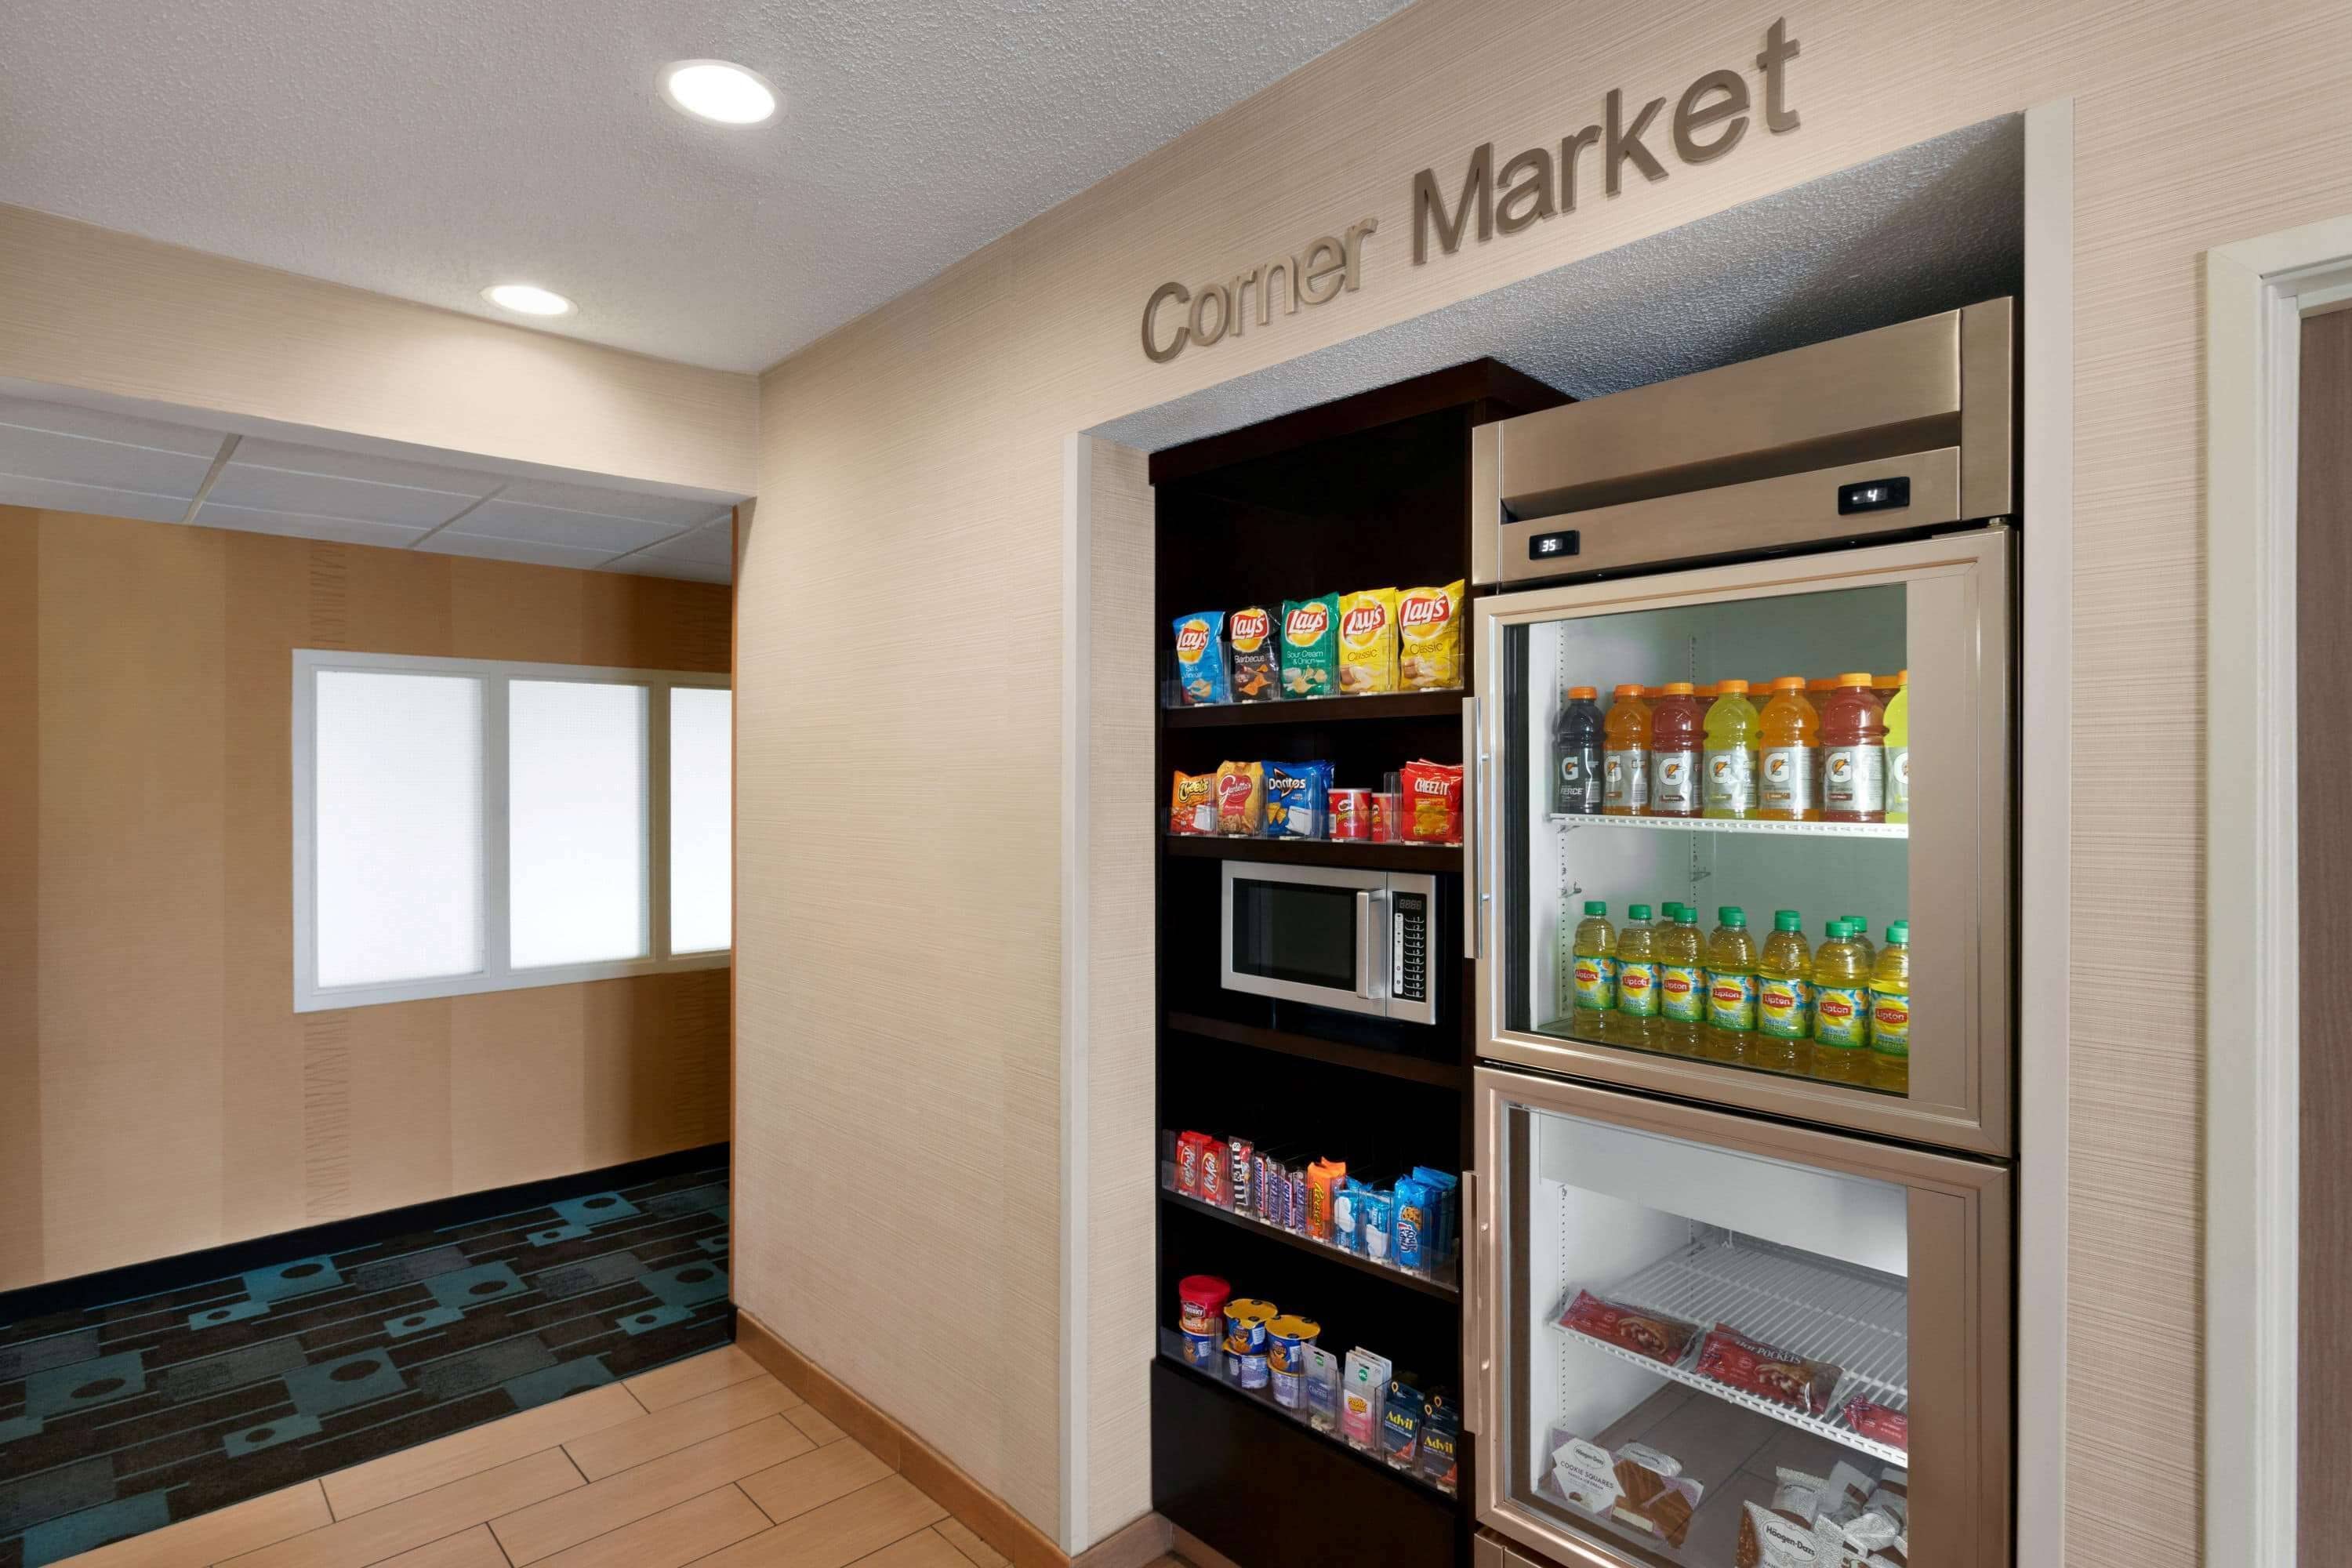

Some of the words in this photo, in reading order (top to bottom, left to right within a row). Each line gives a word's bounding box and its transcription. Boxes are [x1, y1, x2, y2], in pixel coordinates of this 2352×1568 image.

[1141, 216, 1378, 362] Corner
[1413, 16, 1801, 266] Market
[1541, 539, 1556, 552] 35
[1403, 593, 1446, 626] Lay's
[1232, 613, 1265, 640] Lay's
[1288, 611, 1327, 633] Lay's
[1177, 629, 1208, 651] Lay's
[1410, 643, 1443, 655] Classic
[1235, 655, 1265, 663] Barbecue
[1348, 649, 1377, 662] Classic
[1562, 757, 1579, 781] G
[1659, 757, 1686, 786] G
[1765, 752, 1791, 782] G
[1826, 752, 1851, 782] G
[1269, 778, 1306, 790] Doritos
[1337, 811, 1356, 822] Prin
[1576, 971, 1596, 979] Lipton
[1664, 981, 1686, 990] Lipton
[1765, 995, 1790, 1005] Lipton
[1823, 1004, 1849, 1013] Lipton
[1876, 1011, 1904, 1020] Lipton
[1386, 1410, 1414, 1431] Advil
[1424, 1436, 1454, 1454] Advil
[1560, 1461, 1584, 1475] COOKIE
[1584, 1472, 1613, 1489] SQUARES
[1766, 1525, 1816, 1556] Häagen-Dazs
